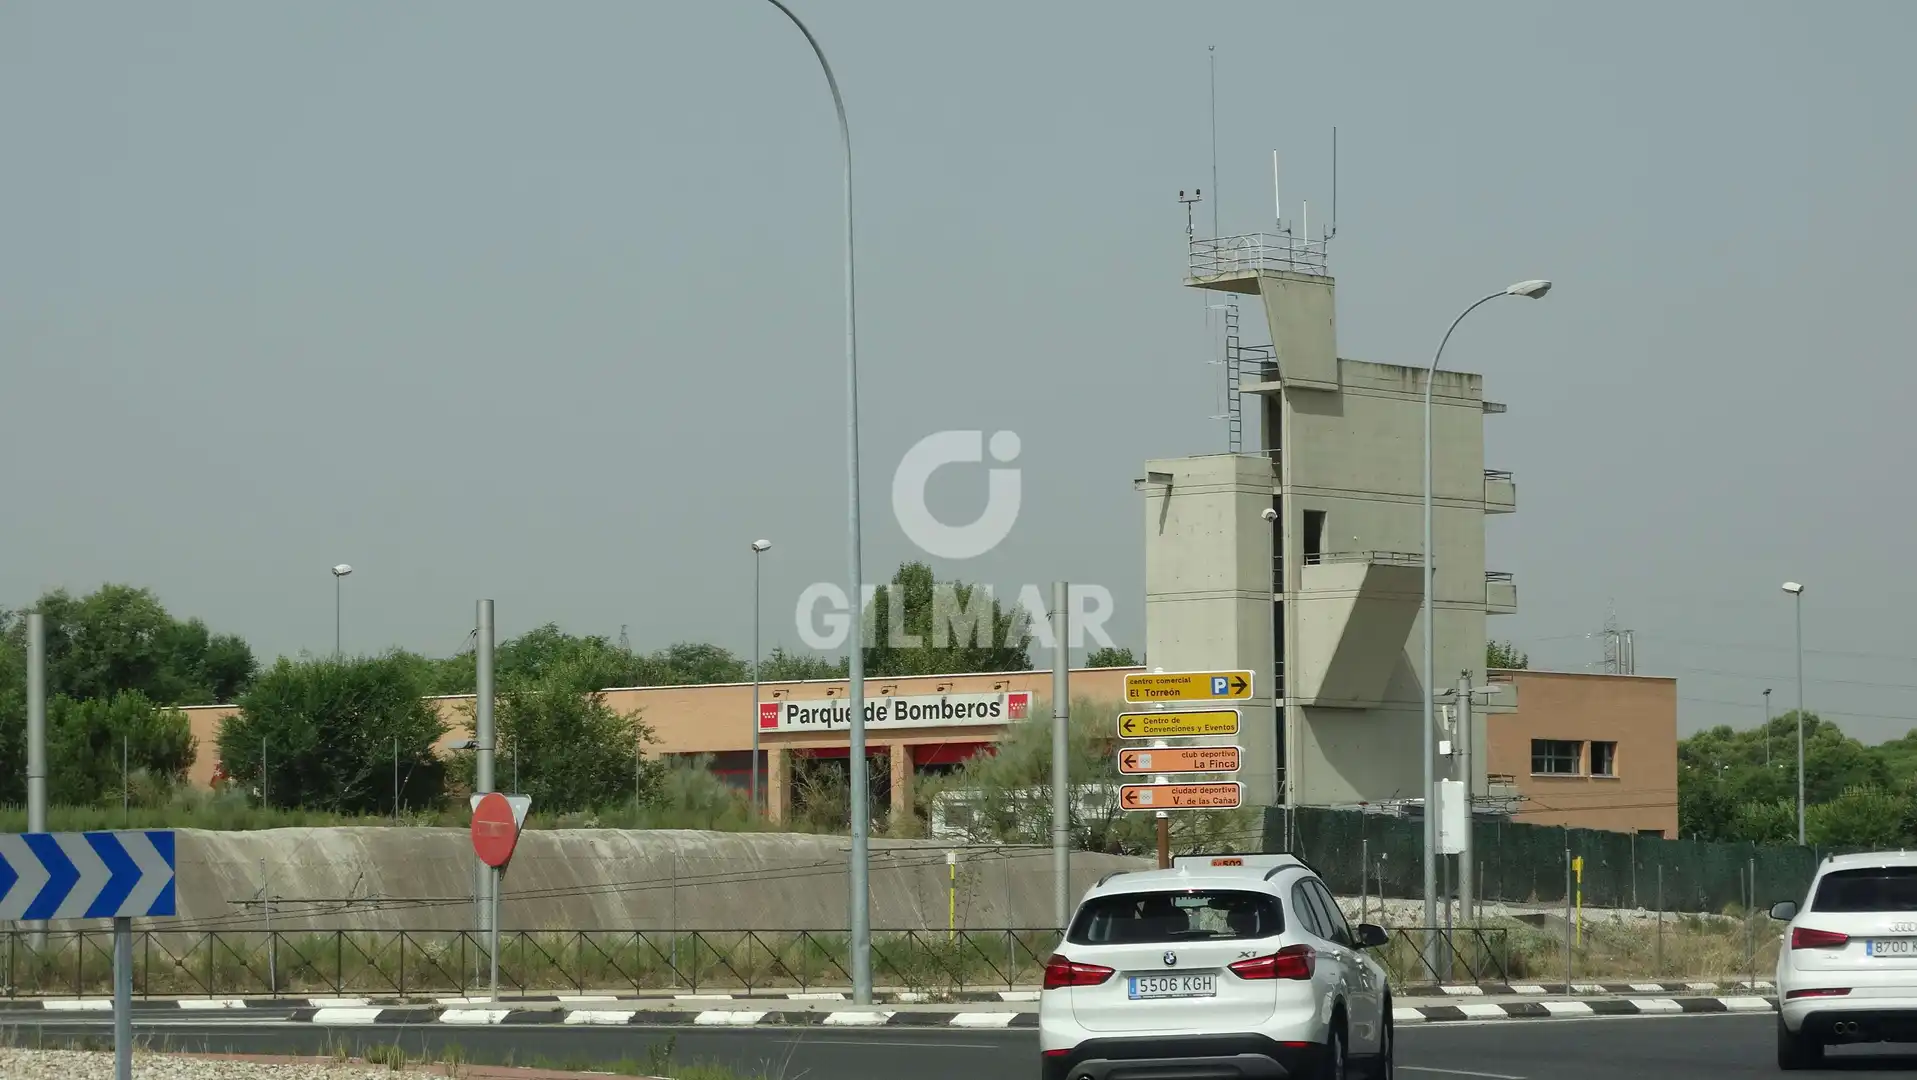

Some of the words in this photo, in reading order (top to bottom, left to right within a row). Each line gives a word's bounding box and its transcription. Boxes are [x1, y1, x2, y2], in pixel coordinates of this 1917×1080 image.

[1214, 678, 1226, 694] P
[864, 702, 887, 721] de
[895, 699, 1000, 720] Bomberos
[1195, 760, 1205, 768] La
[1210, 760, 1236, 768] Finca
[1200, 787, 1236, 795] deportiva
[1173, 796, 1182, 804] V.
[1876, 941, 1907, 952] 8700
[1140, 978, 1177, 992] 5506
[1183, 976, 1211, 990] KGH
